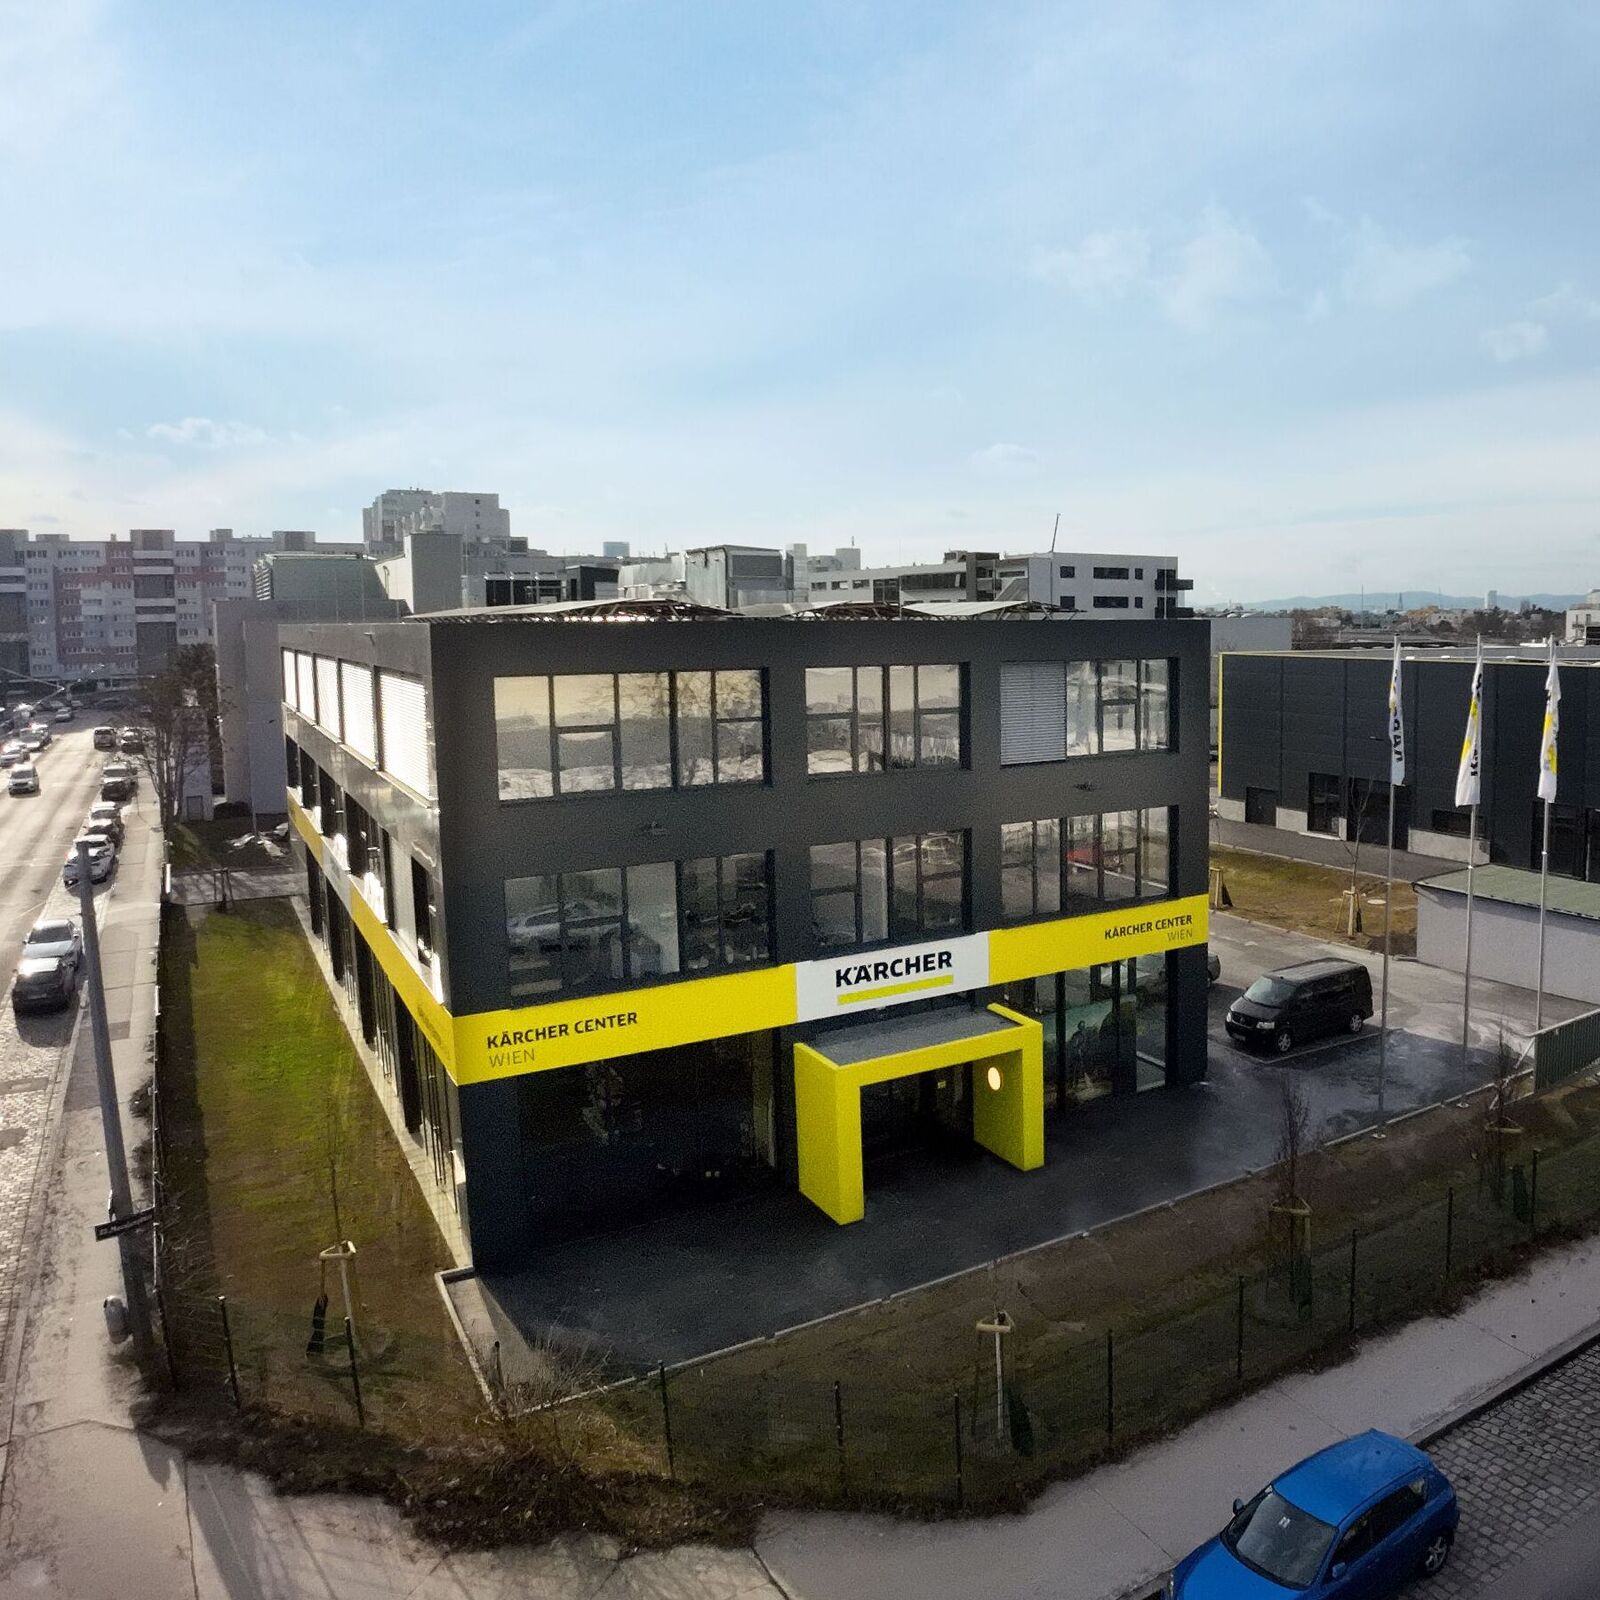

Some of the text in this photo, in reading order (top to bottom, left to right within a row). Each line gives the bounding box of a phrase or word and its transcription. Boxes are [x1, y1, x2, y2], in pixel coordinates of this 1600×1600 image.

[1155, 914, 1193, 930] CENTER
[1167, 927, 1193, 941] WIEN
[835, 950, 953, 988] KÄRCHER
[487, 1011, 638, 1049] KÄRCHER CENTER
[488, 1047, 536, 1068] WIEN
